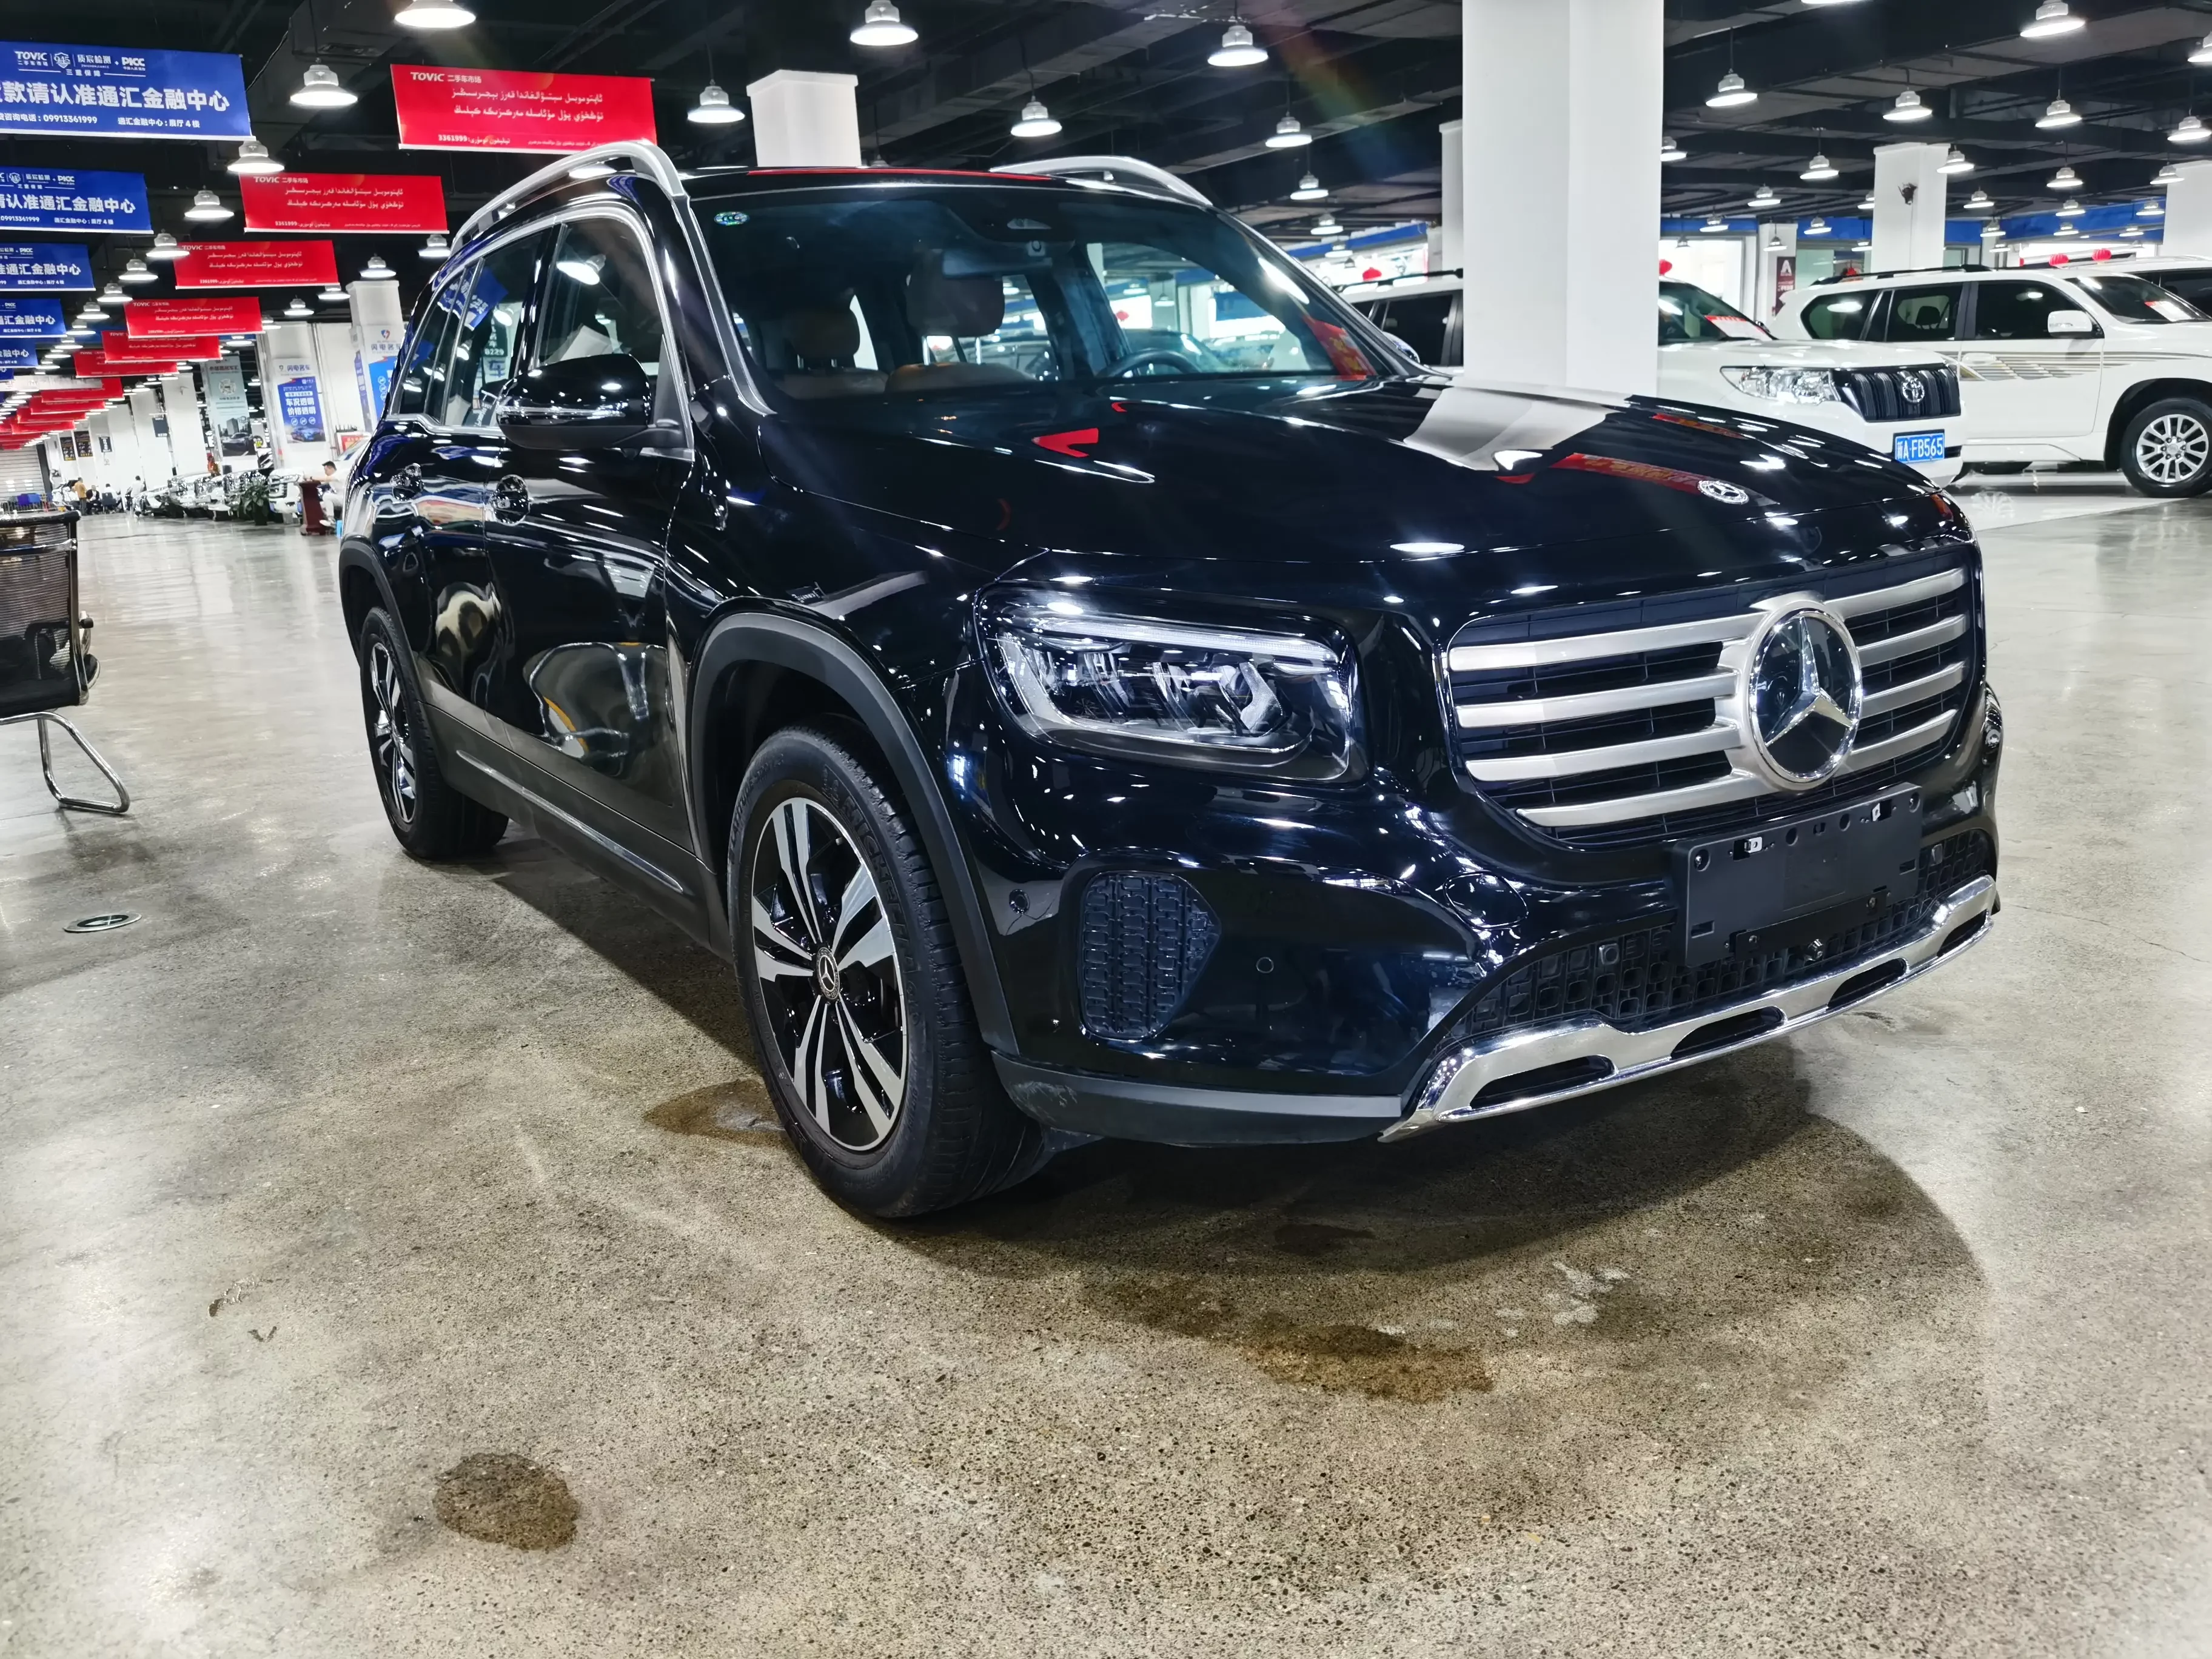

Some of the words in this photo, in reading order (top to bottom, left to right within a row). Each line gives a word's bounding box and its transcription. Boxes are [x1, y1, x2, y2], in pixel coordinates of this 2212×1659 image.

[15, 51, 48, 61] TOVIC
[121, 57, 146, 66] PICC
[410, 72, 445, 82] TOVIC
[447, 74, 482, 84] 二手车市场
[0, 81, 230, 112] 款请认准通汇金融中心
[0, 349, 29, 358] 融中心
